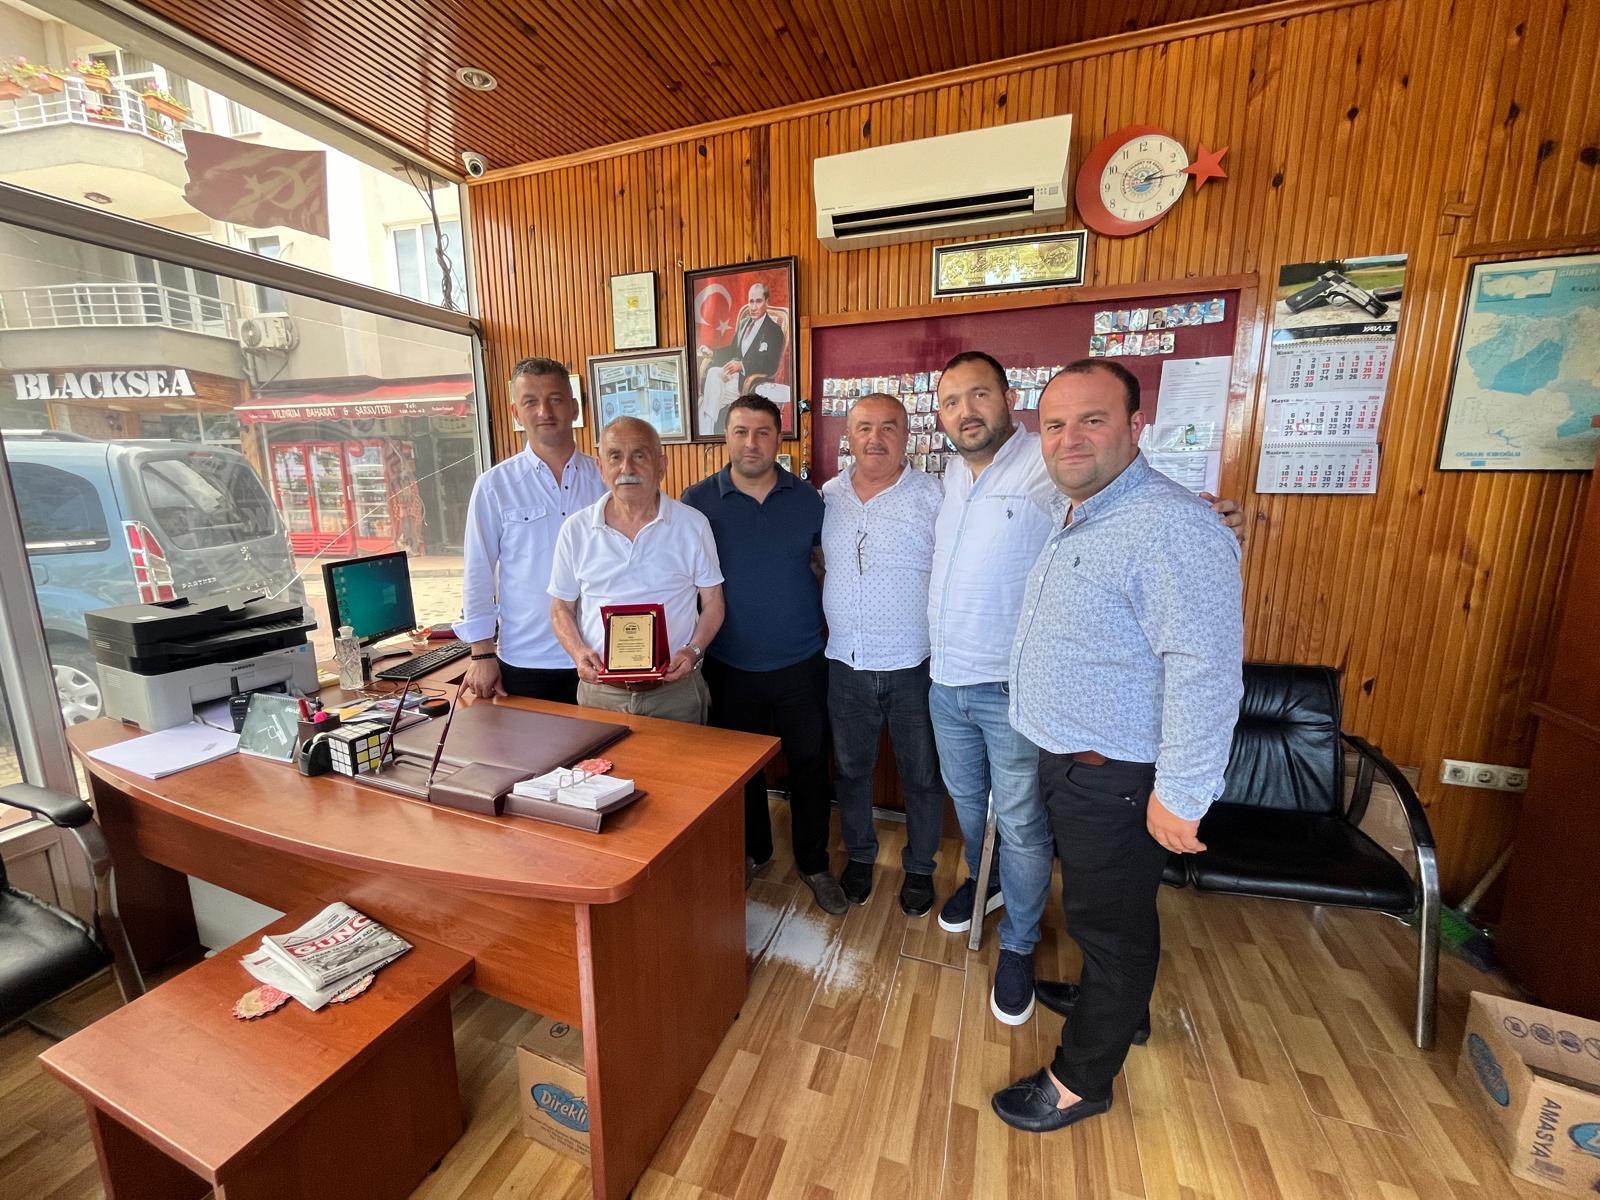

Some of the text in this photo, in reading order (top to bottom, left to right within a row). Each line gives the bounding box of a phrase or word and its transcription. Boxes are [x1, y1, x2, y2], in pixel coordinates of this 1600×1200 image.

[1139, 142, 1148, 152] 12
[1122, 150, 1129, 160] 11
[1169, 153, 1177, 163] 2
[1108, 165, 1118, 175] 10
[1104, 183, 1111, 193] 9
[1169, 188, 1175, 196] 4
[1109, 199, 1116, 208] 8
[1156, 202, 1162, 211] 5
[1122, 208, 1127, 218] 7
[1138, 210, 1144, 219] 6
[13, 369, 196, 400] BLACKSEA
[305, 408, 335, 417] BAHARAT
[182, 577, 217, 589] PARTNER
[540, 1089, 587, 1123] Direkli
[1529, 1096, 1562, 1159] AMASYA
